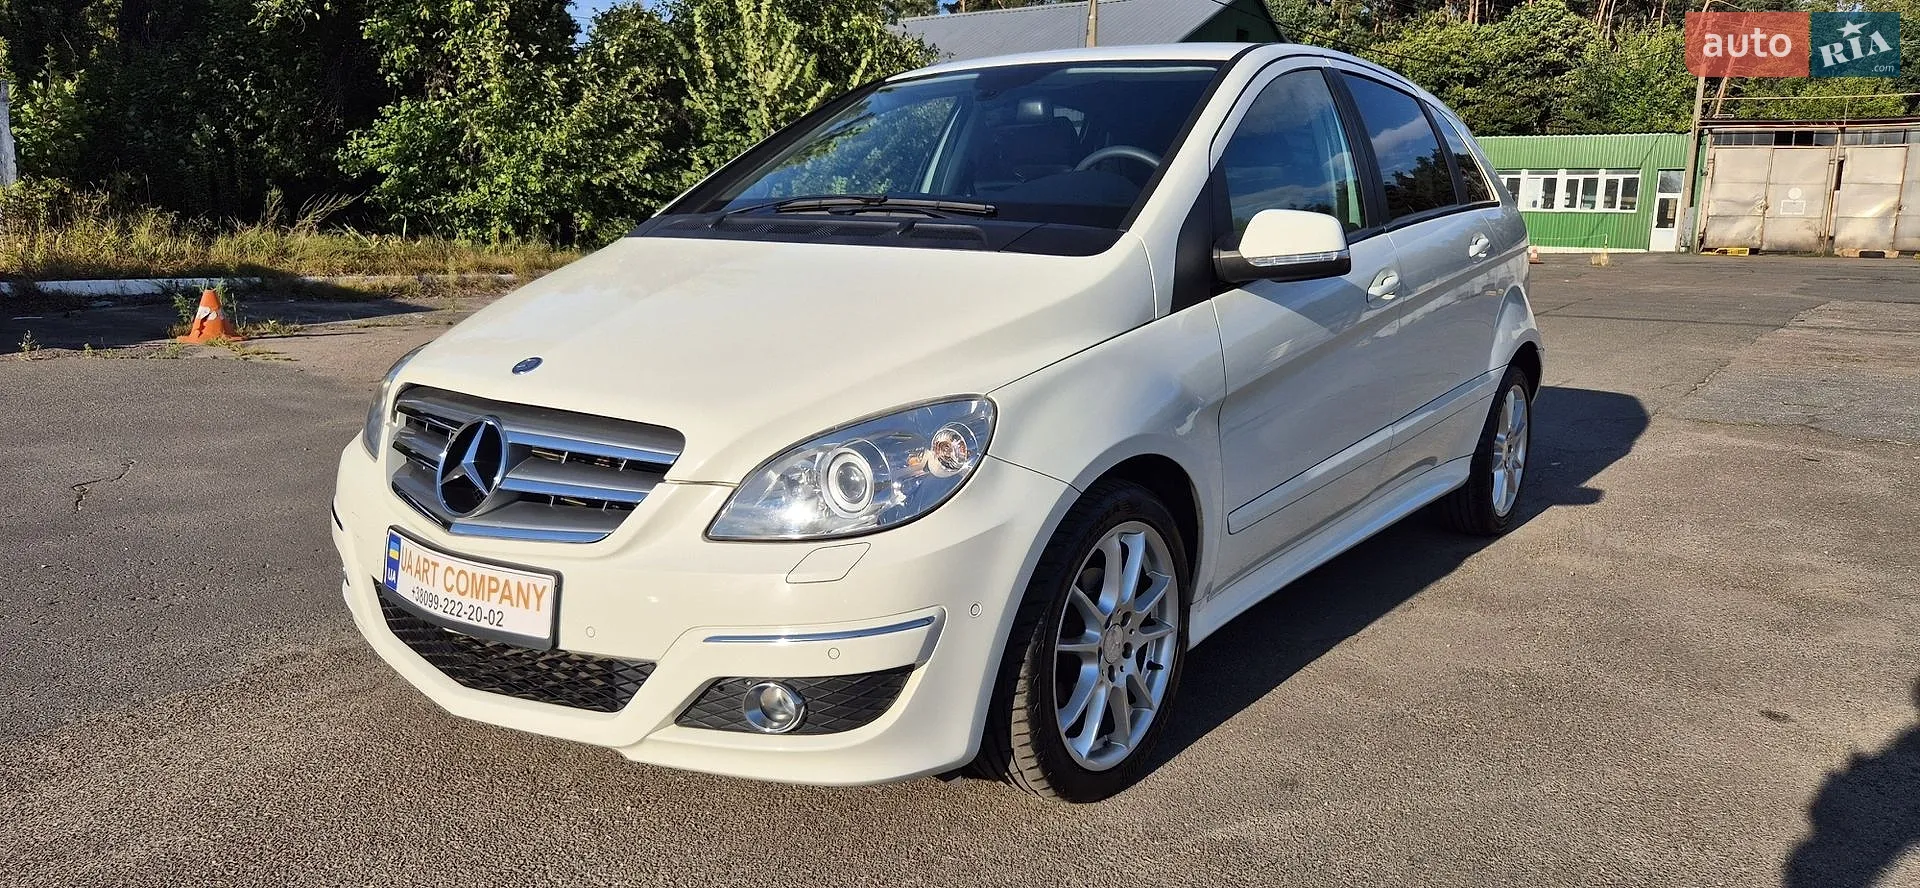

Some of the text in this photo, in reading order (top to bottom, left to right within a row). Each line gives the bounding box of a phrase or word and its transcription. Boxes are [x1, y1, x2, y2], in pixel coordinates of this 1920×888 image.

[388, 567, 397, 584] UA
[401, 545, 548, 612] UA ART COMPANY
[411, 586, 504, 628] +38099-222-20-02
